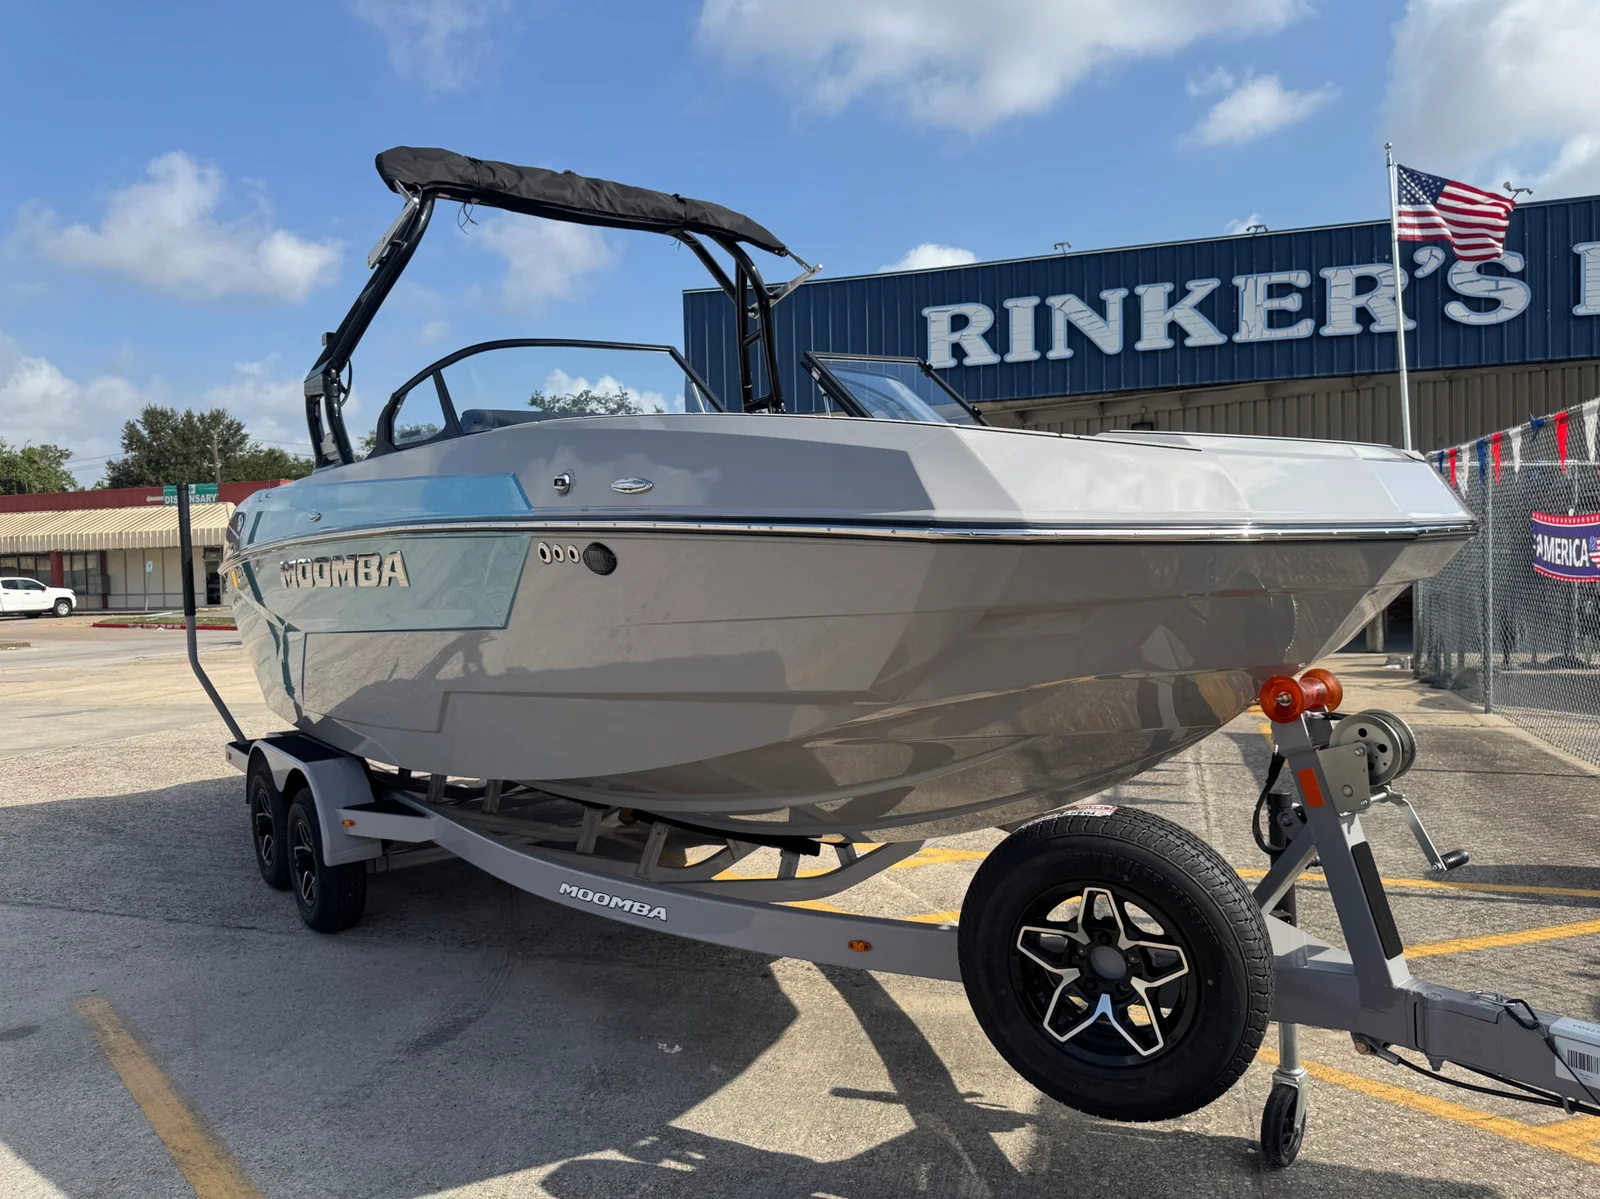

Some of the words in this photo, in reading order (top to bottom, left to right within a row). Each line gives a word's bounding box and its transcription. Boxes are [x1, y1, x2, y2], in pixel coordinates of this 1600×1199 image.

[921, 246, 1532, 369] RINKER'S
[164, 493, 217, 505] DISNSARY
[280, 550, 411, 588] MOOMBA
[1536, 533, 1590, 568] AMERICA
[559, 882, 667, 921] MOOMBA
